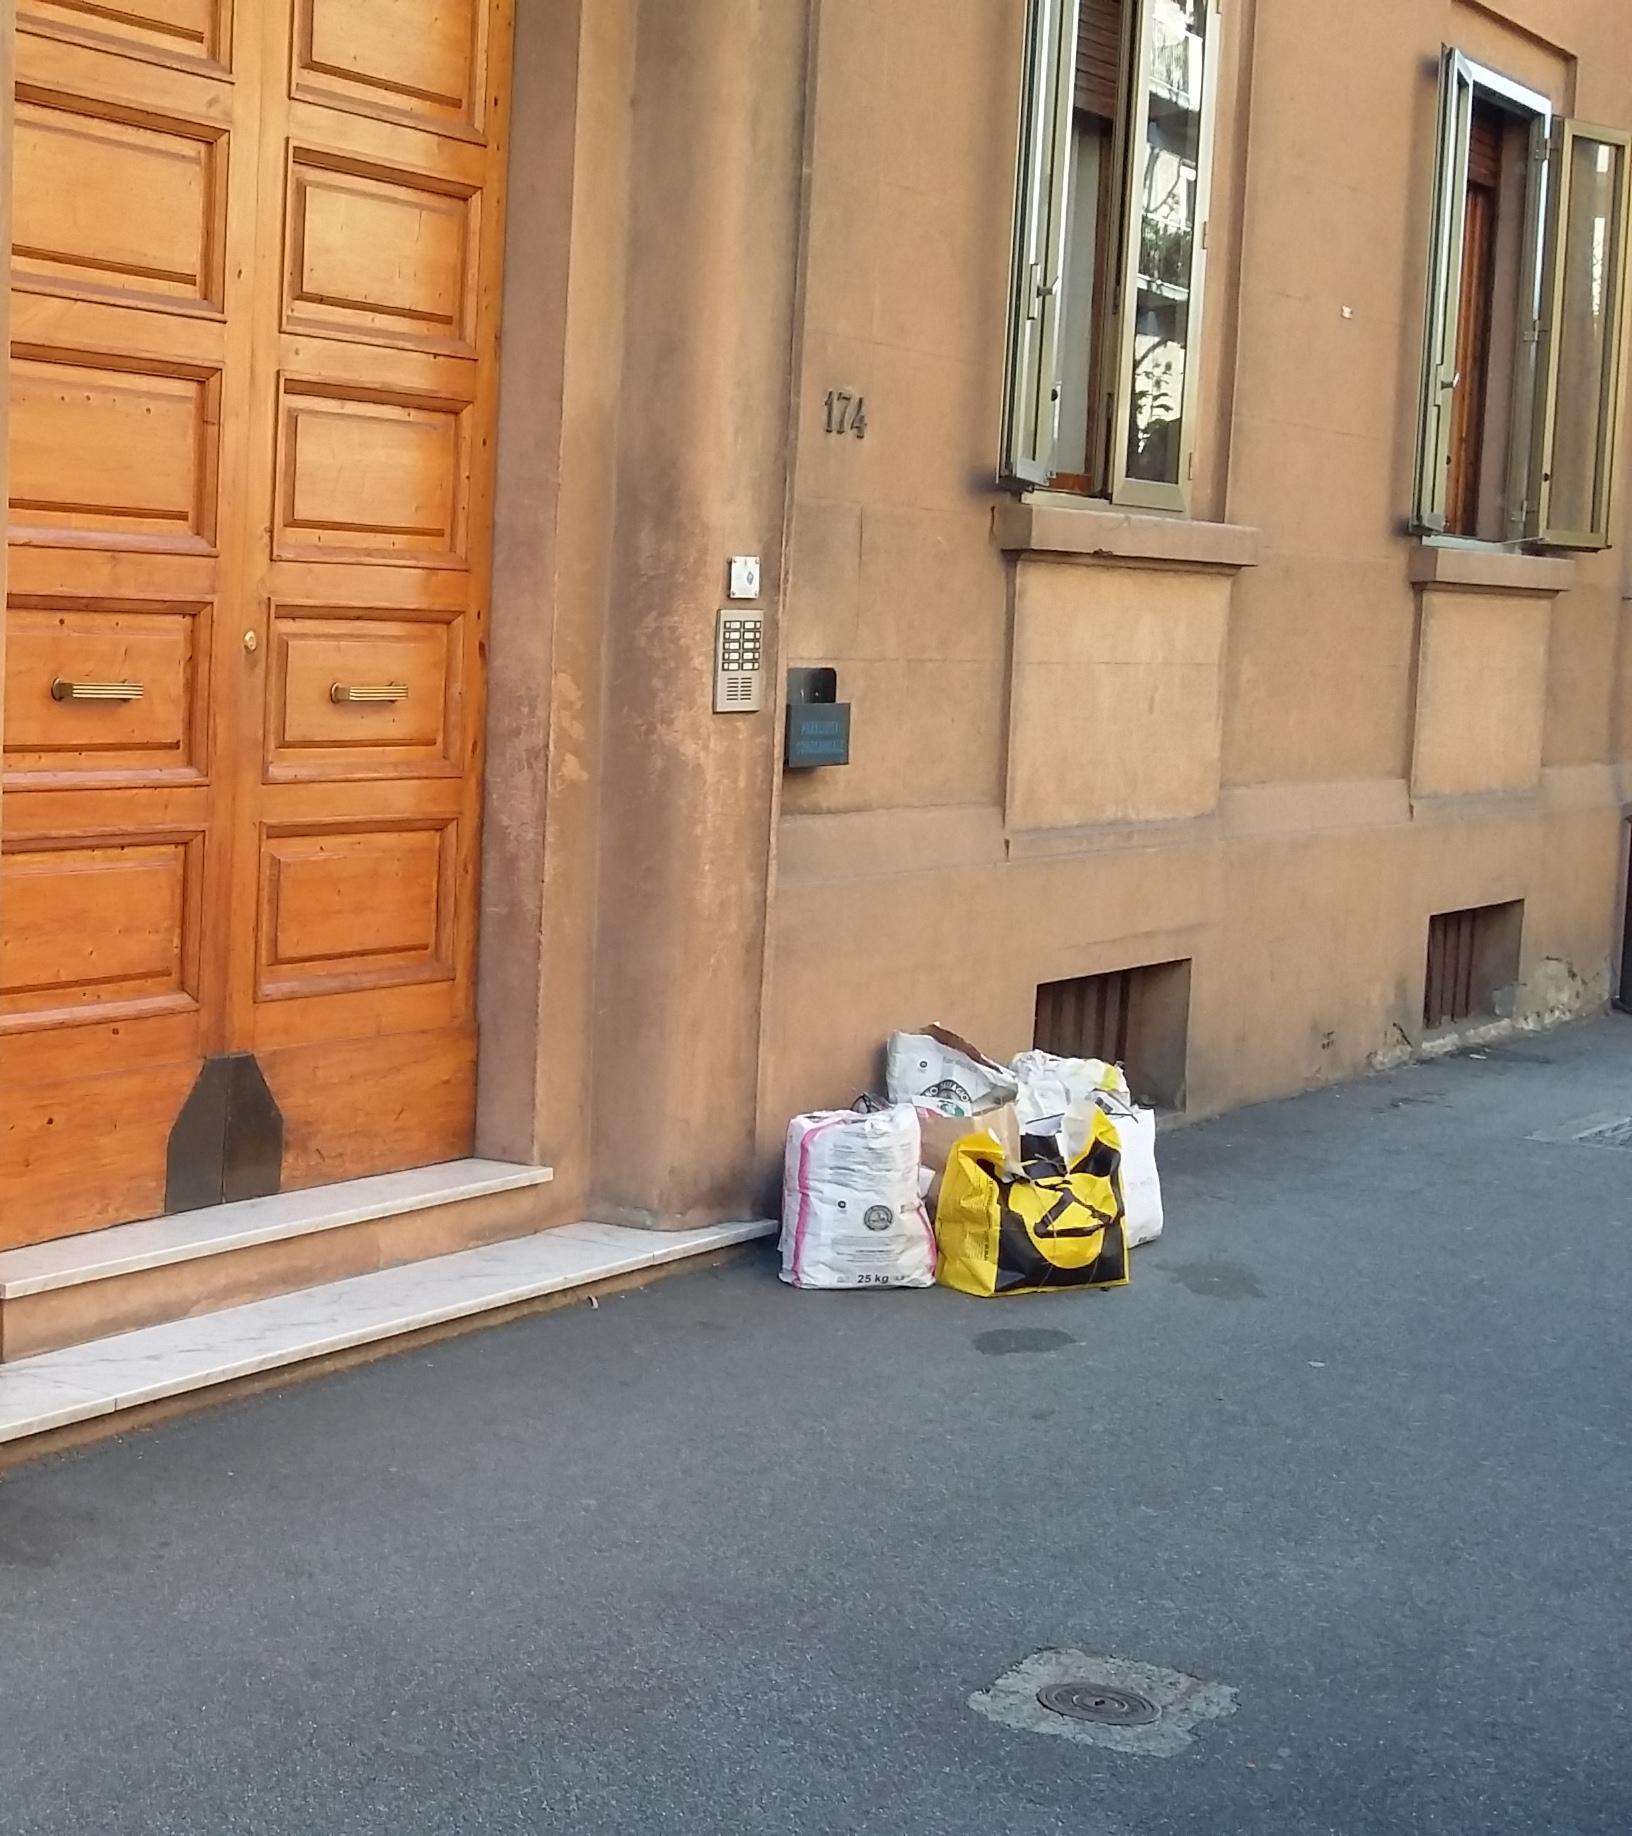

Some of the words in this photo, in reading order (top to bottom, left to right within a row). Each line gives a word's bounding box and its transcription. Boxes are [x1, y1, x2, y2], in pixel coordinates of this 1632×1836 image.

[824, 390, 867, 439] 174
[857, 1274, 871, 1284] 25
[875, 1274, 889, 1284] kg
